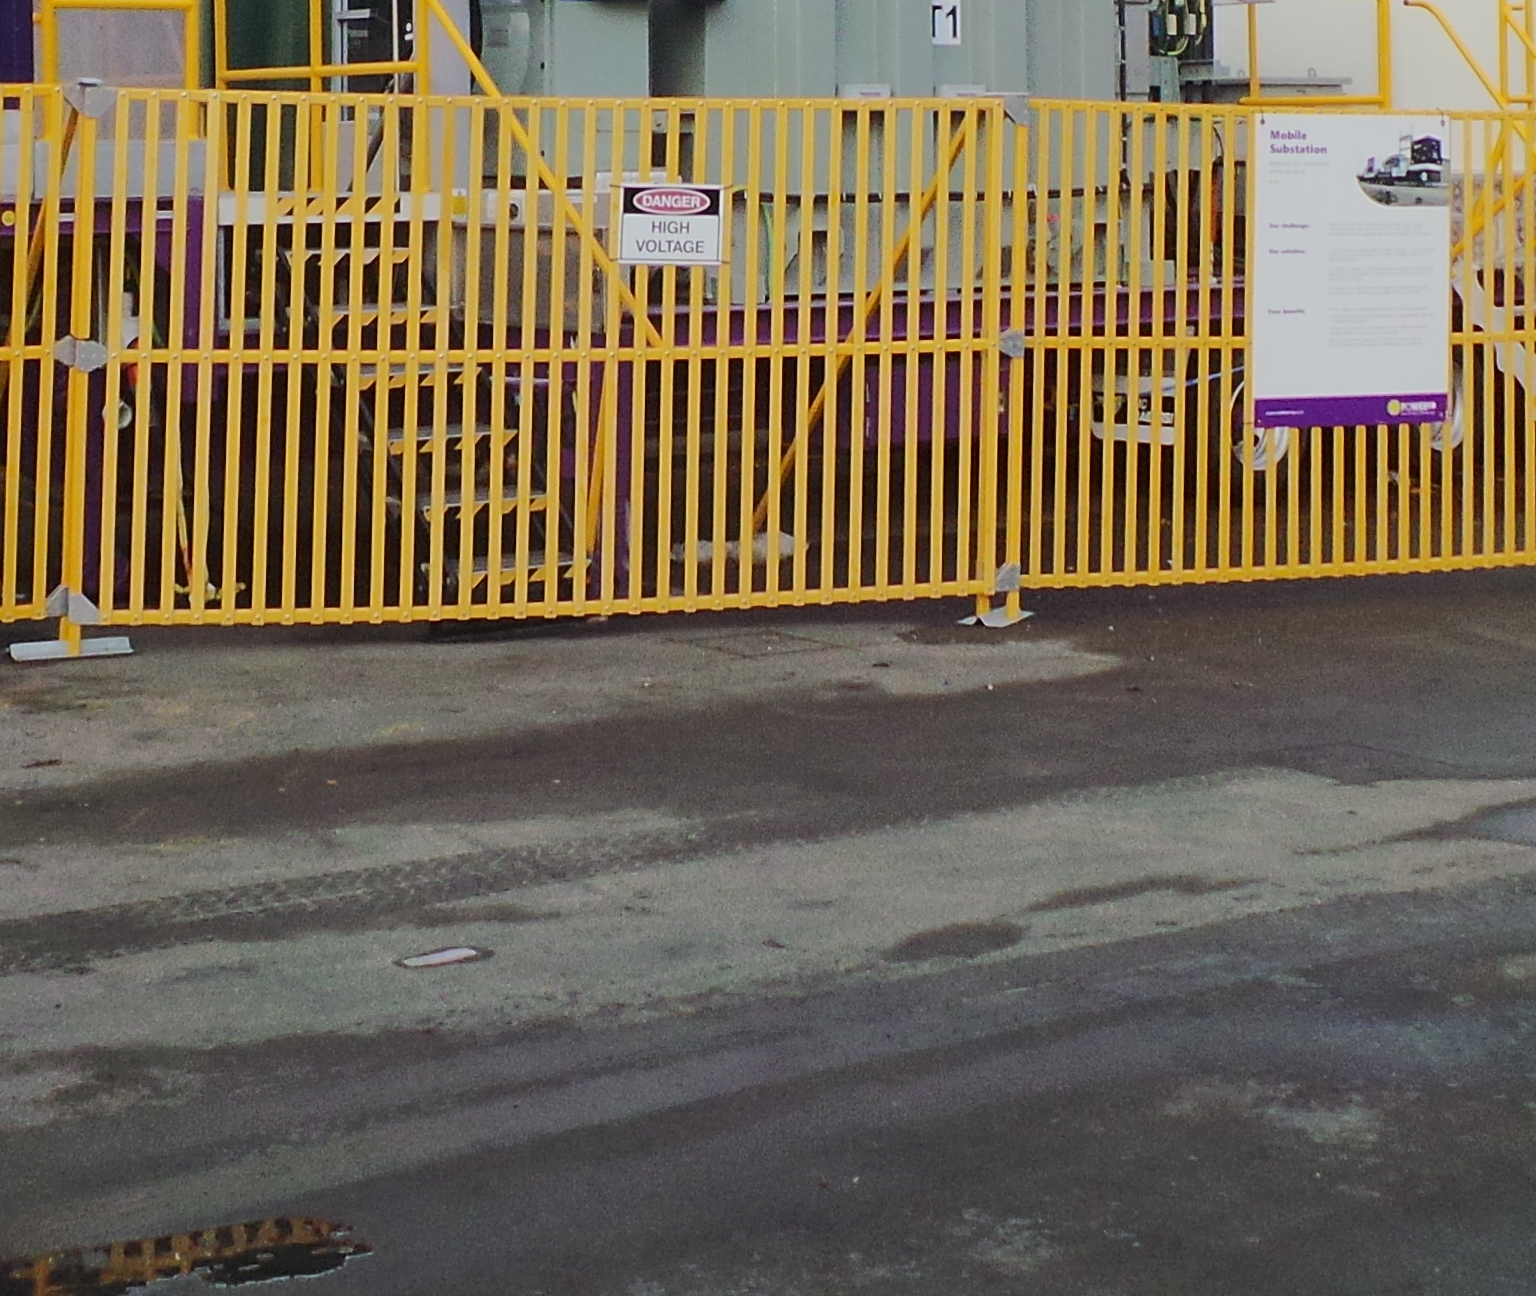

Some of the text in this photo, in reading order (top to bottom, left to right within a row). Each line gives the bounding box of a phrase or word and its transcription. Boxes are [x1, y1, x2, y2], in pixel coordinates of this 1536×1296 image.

[1270, 130, 1307, 141] Mobile
[1270, 143, 1328, 154] Substation
[642, 194, 701, 208] DANGER
[651, 221, 690, 234] HIGH
[635, 239, 705, 253] VOLTAGE
